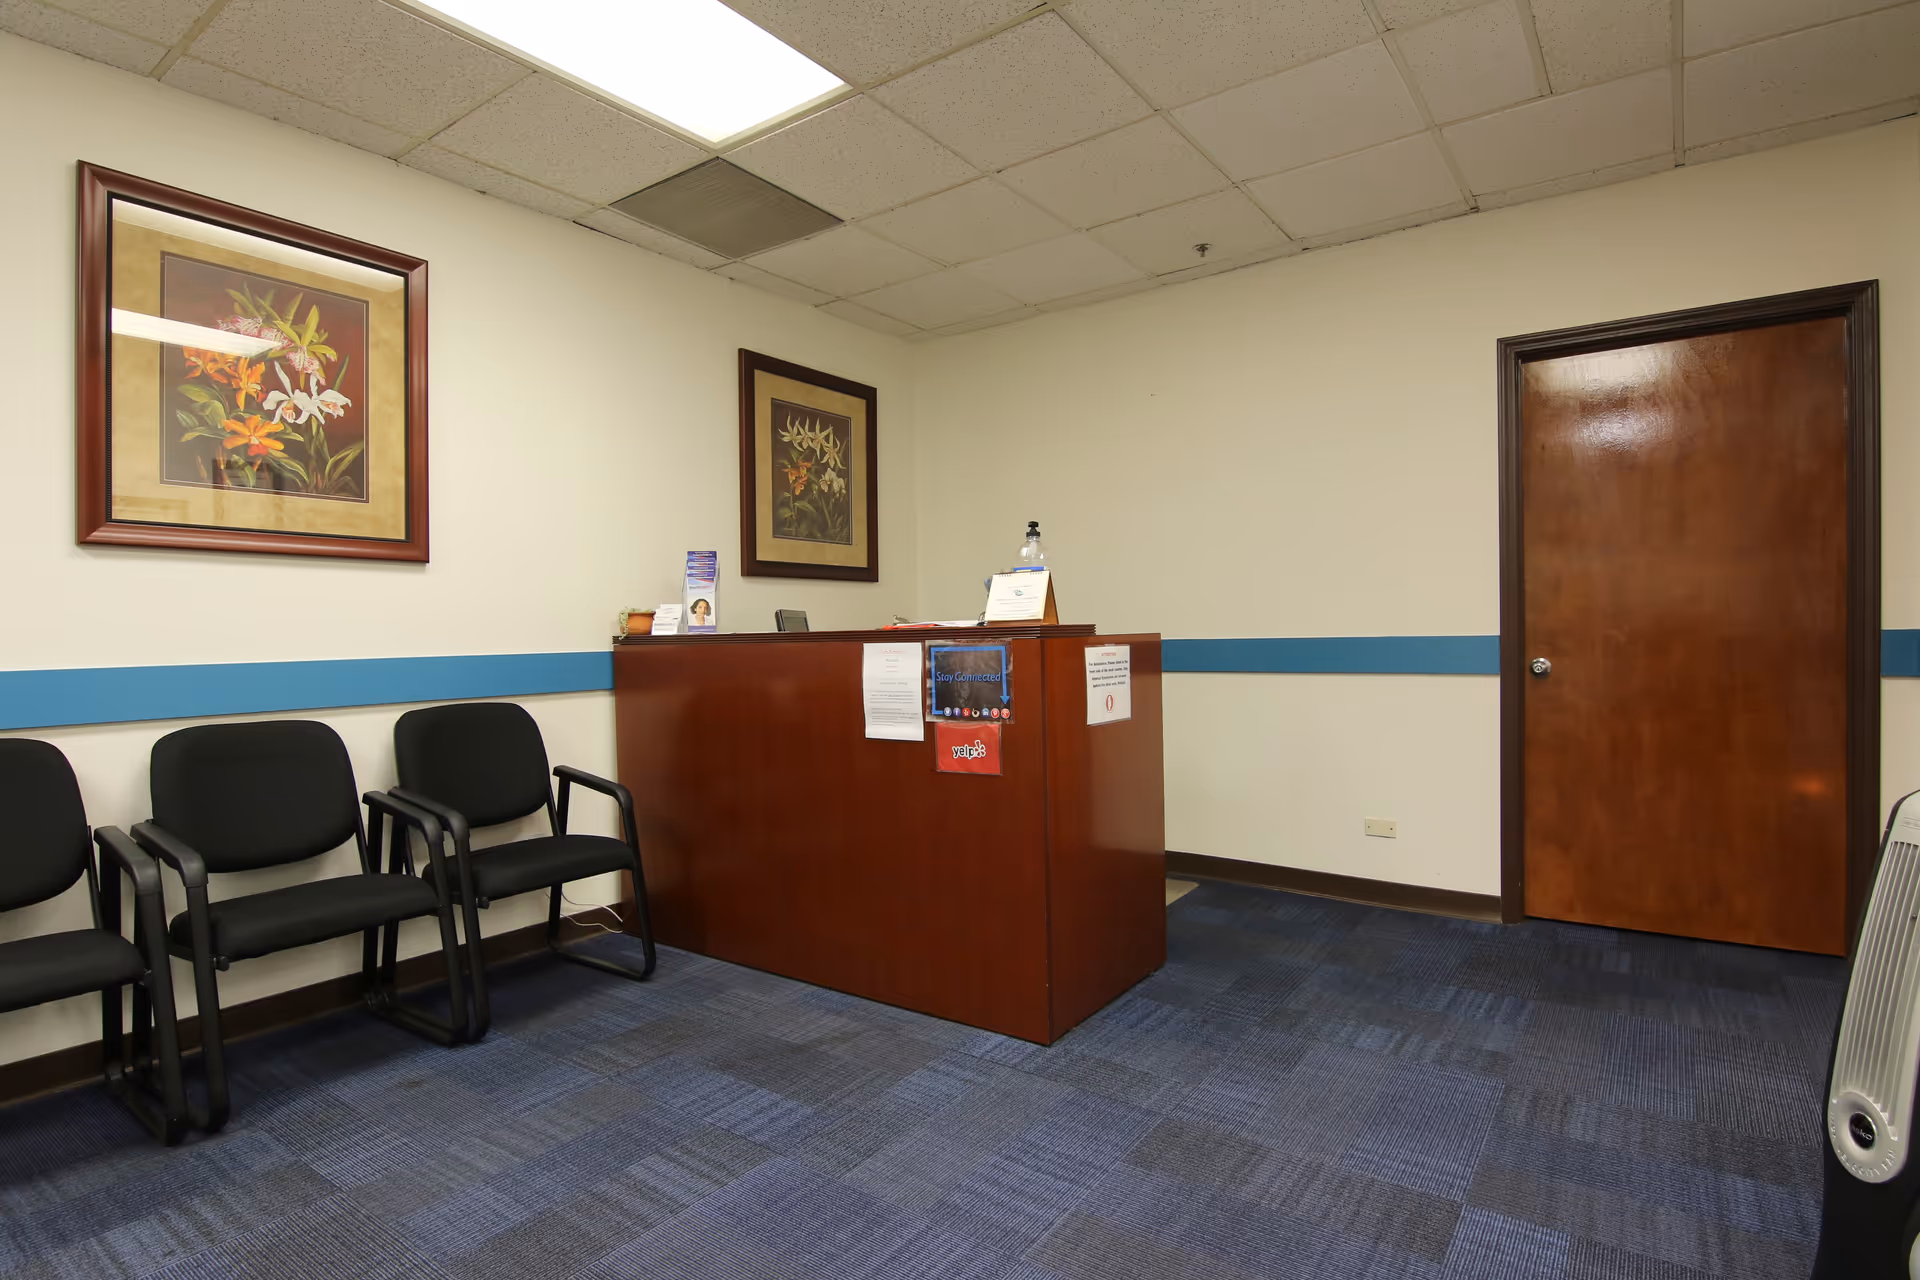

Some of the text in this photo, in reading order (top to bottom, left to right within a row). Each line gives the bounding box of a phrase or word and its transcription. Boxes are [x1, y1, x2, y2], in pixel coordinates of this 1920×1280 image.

[936, 671, 1001, 683] Stay Connected
[952, 744, 975, 760] yelp
